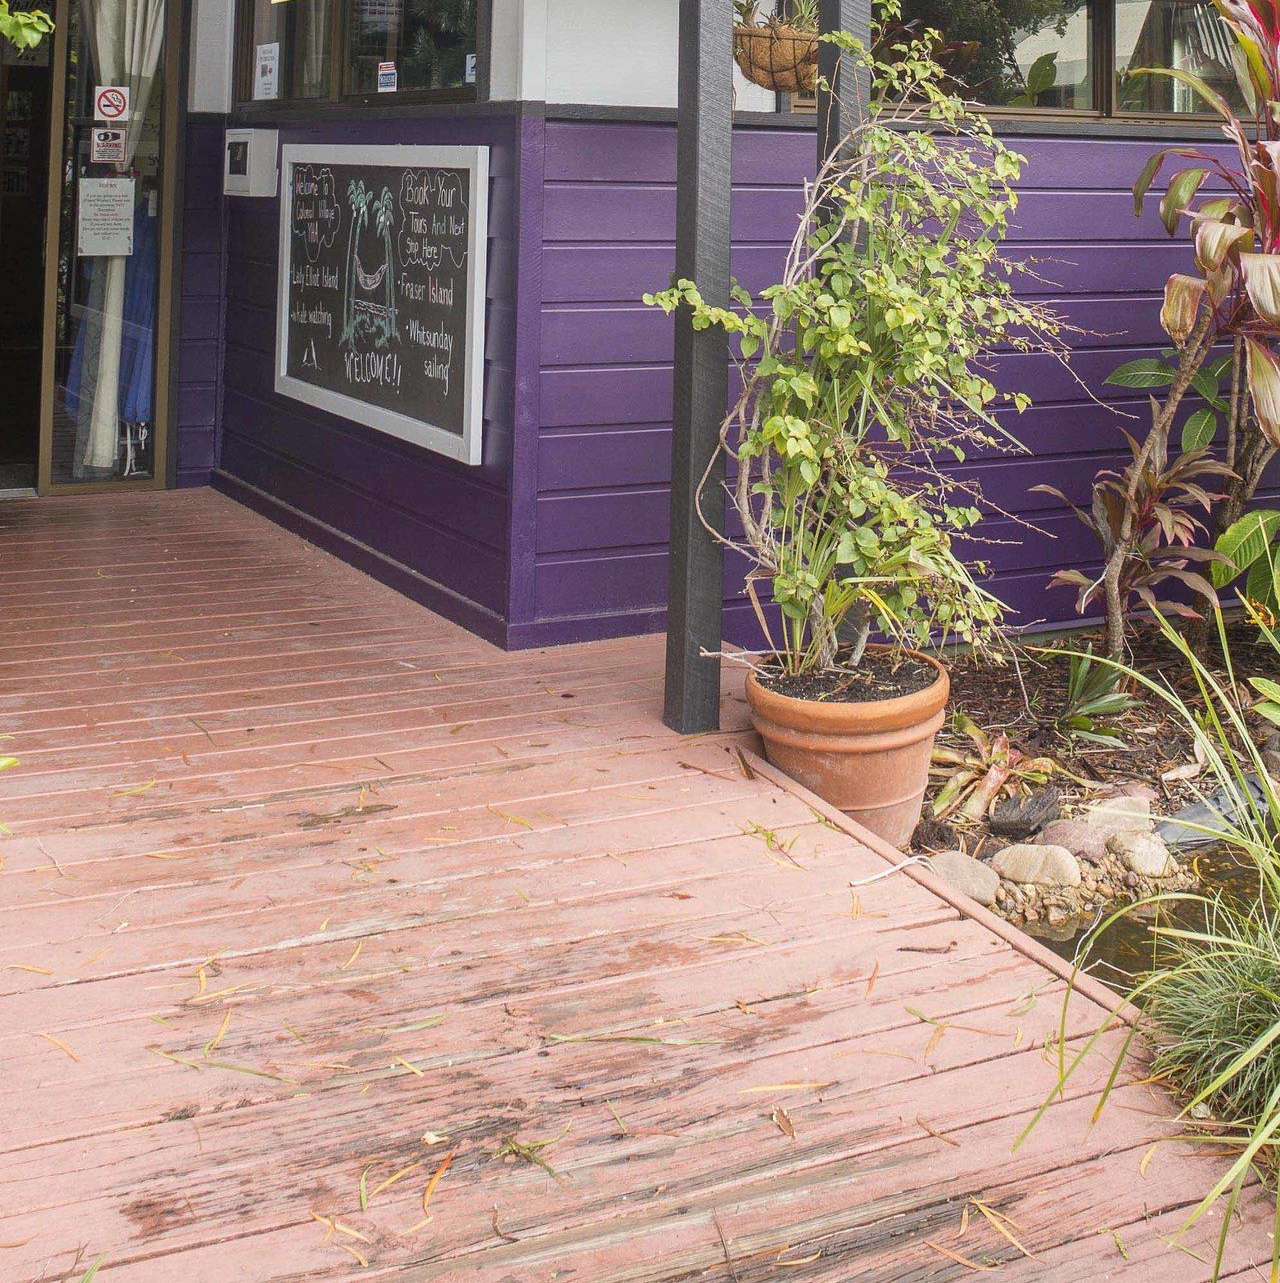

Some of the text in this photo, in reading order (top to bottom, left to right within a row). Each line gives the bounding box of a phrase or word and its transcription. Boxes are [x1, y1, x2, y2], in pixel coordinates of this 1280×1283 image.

[295, 170, 318, 196] Welcome
[405, 174, 456, 207] Book Your
[409, 211, 465, 236] Tours And Next
[422, 237, 438, 259] Here
[293, 263, 305, 293] Lady
[322, 266, 339, 290] Island
[401, 272, 453, 306] Fraser Island
[309, 300, 332, 339] watching
[409, 318, 454, 368] Whitsunday
[424, 354, 450, 396] sailing
